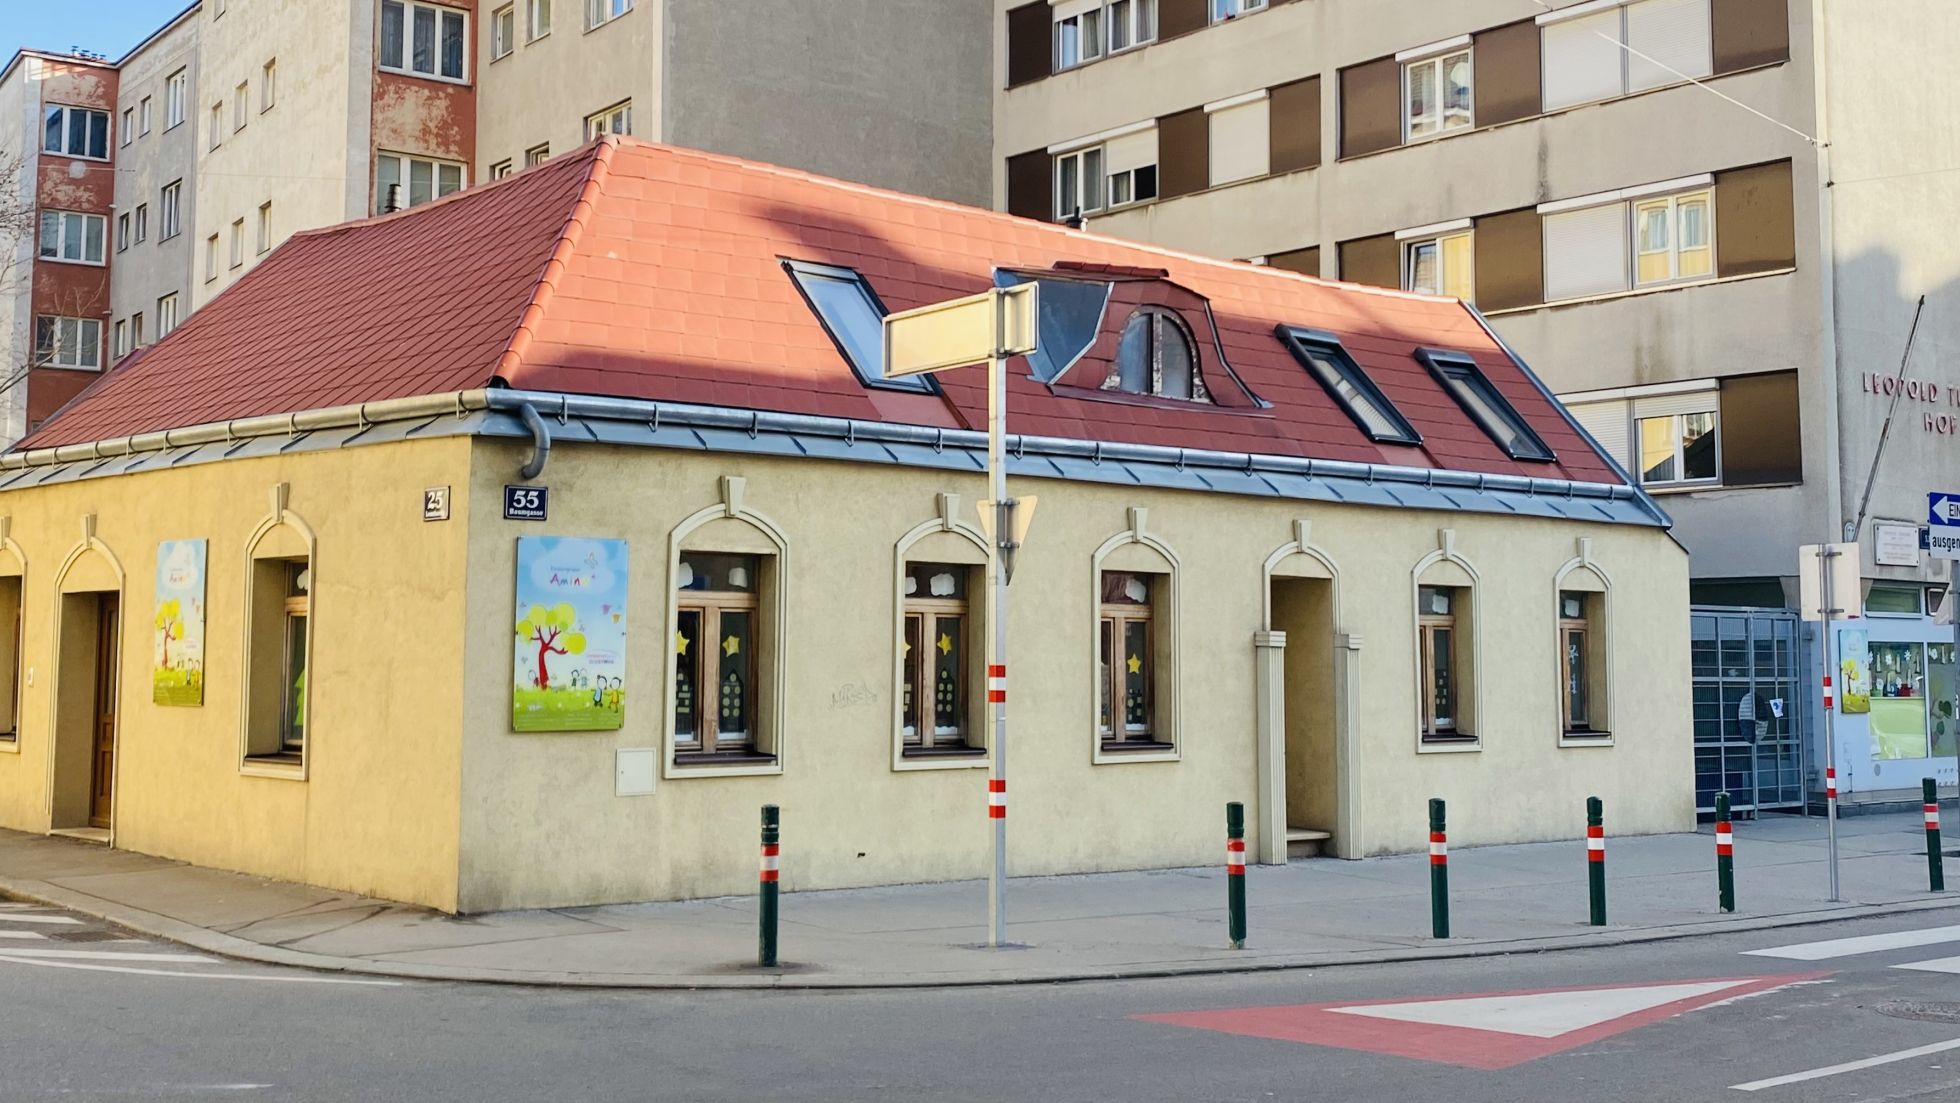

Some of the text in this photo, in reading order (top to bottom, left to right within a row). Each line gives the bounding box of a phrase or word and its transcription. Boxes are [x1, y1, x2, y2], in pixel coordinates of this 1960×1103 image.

[1862, 372, 1937, 403] LEOPOLD
[1923, 412, 1957, 435] HOF
[427, 491, 442, 509] 25
[512, 490, 539, 508] 55
[509, 507, 544, 517] Baumgasse
